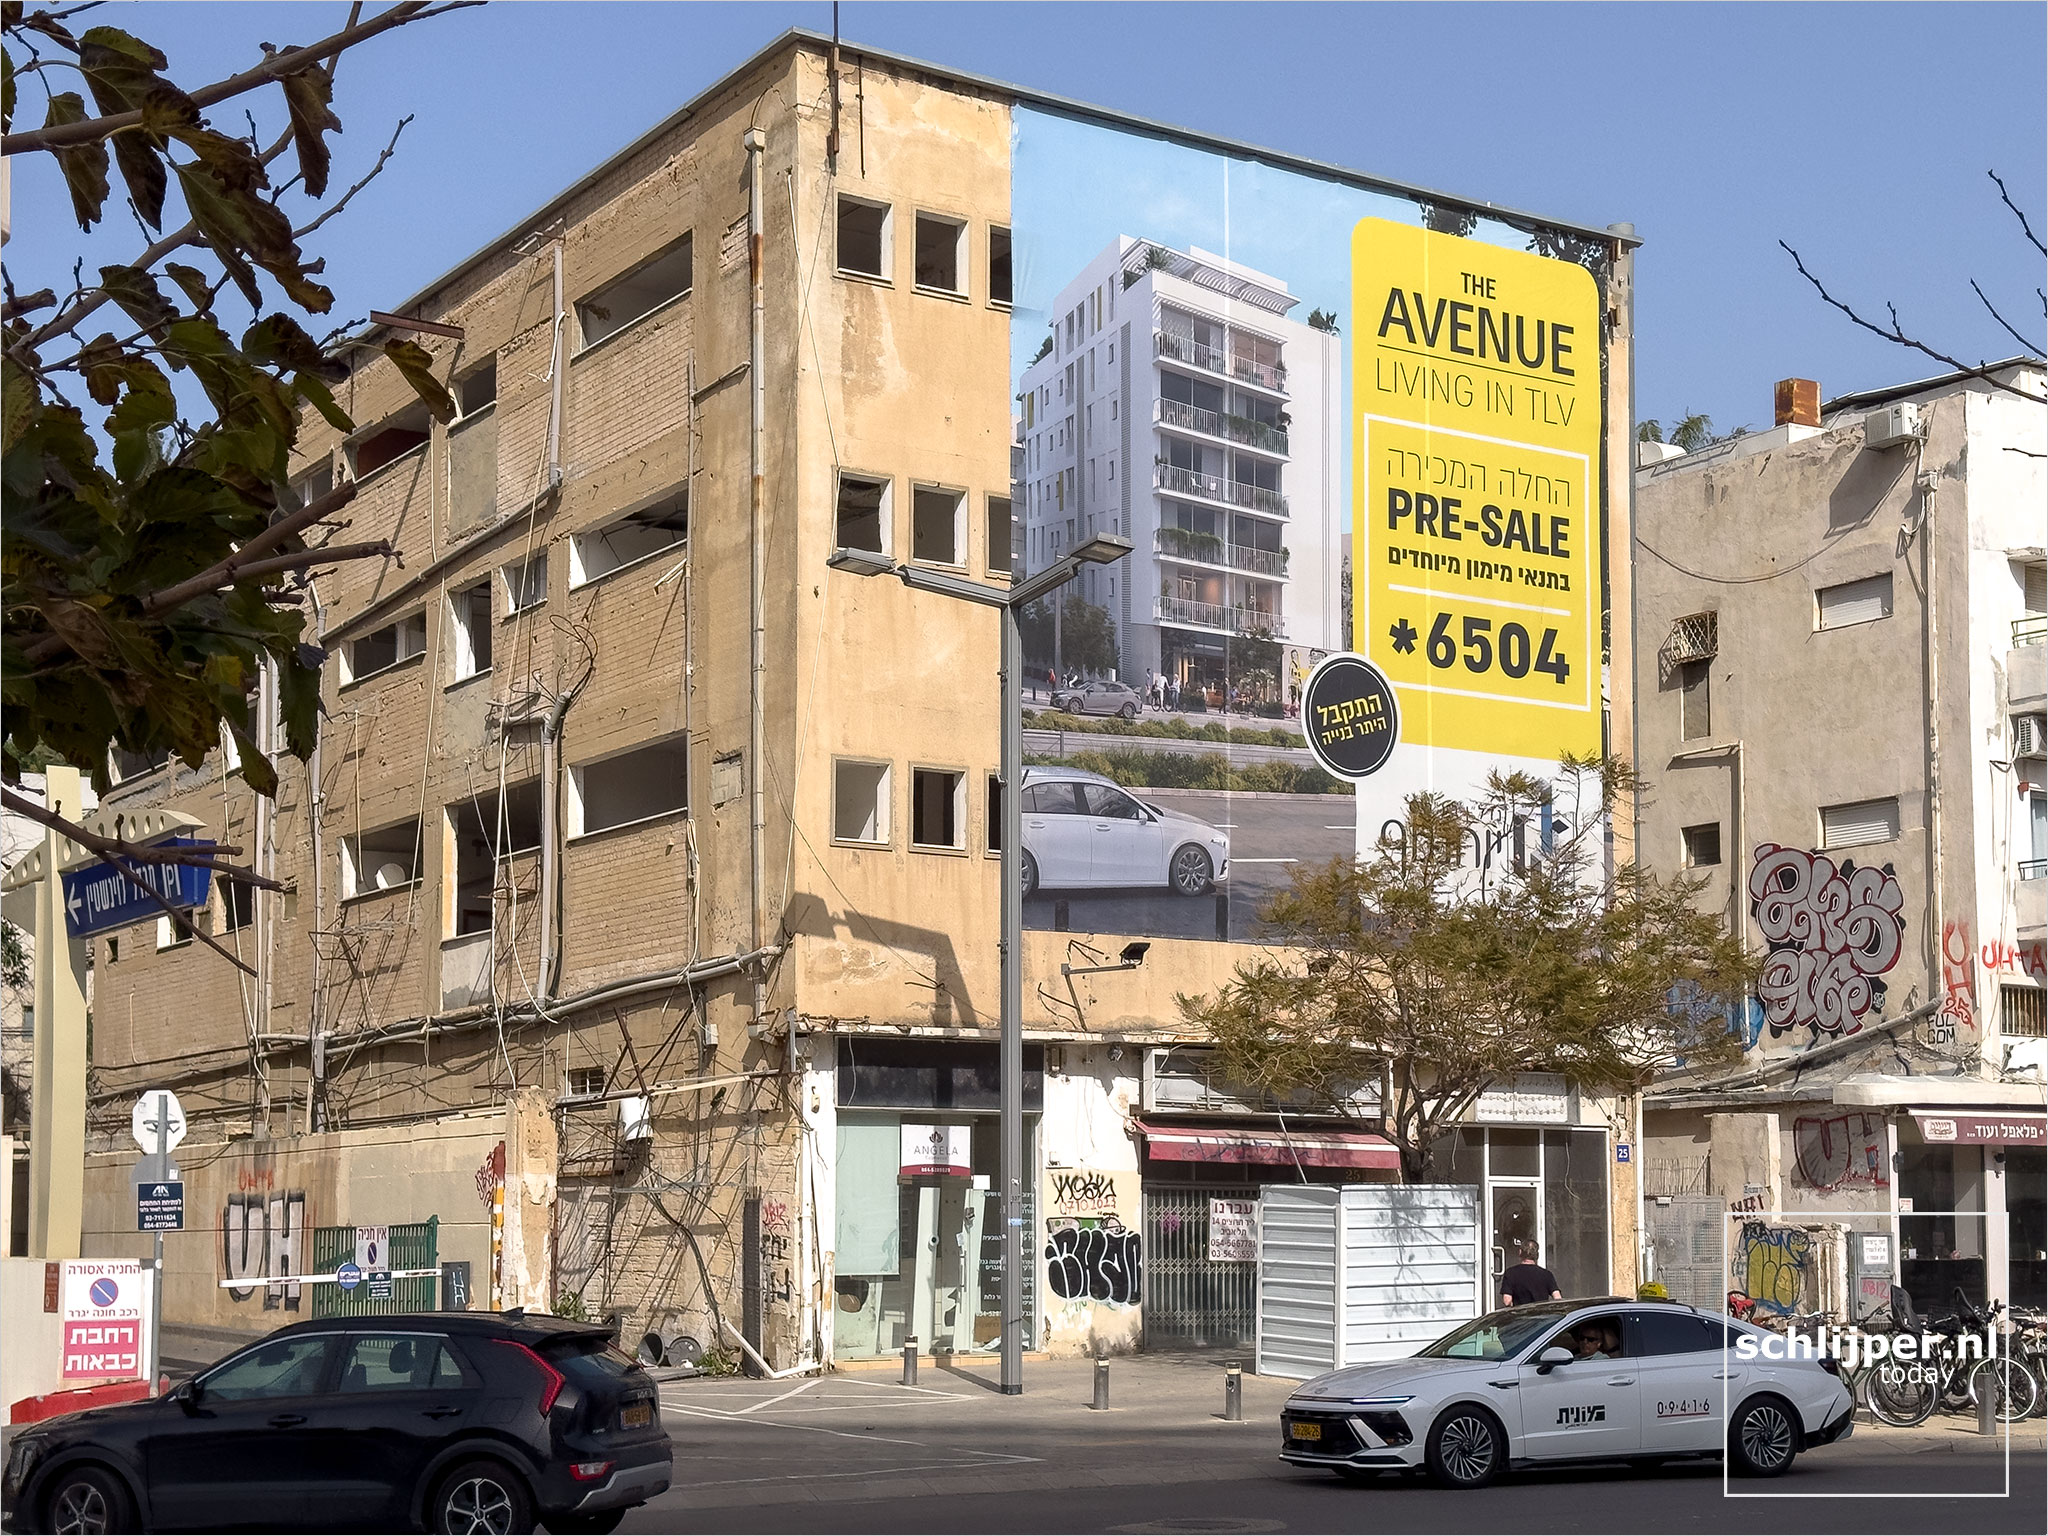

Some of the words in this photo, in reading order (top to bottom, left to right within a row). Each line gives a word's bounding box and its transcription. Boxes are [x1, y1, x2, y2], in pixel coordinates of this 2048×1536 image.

[1461, 272, 1496, 300] THE
[1377, 287, 1575, 377] AVENUE
[1376, 358, 1473, 408] LIVING
[1486, 380, 1513, 416] IN
[1525, 387, 1575, 426] TLV
[1388, 448, 1486, 492] המכירה
[1499, 467, 1570, 507] החלה
[1388, 487, 1570, 559] PRE-SALE
[1388, 546, 1461, 574] מיוחדים
[1466, 562, 1513, 583] מימון
[1518, 567, 1570, 591] בתנאי
[1316, 693, 1382, 726] התקבל
[1355, 716, 1387, 736] היתר
[1321, 726, 1354, 746] בנייה
[2001, 1123, 2038, 1139] פלאפל
[913, 1145, 958, 1156] ANGELA
[1618, 1148, 1628, 1158] 25
[1214, 1202, 1253, 1214] עברנו
[1212, 1217, 1220, 1225] 14
[358, 1227, 375, 1241] חניה
[377, 1227, 387, 1243] אין
[68, 1264, 104, 1275] אסורה
[108, 1264, 141, 1275] החניה
[68, 1309, 89, 1318] יגרר
[92, 1309, 116, 1317] חונה
[119, 1308, 138, 1317] רכב
[70, 1327, 134, 1345] רחבת
[65, 1353, 137, 1372] כבאות
[1556, 1404, 1606, 1425] מונית
